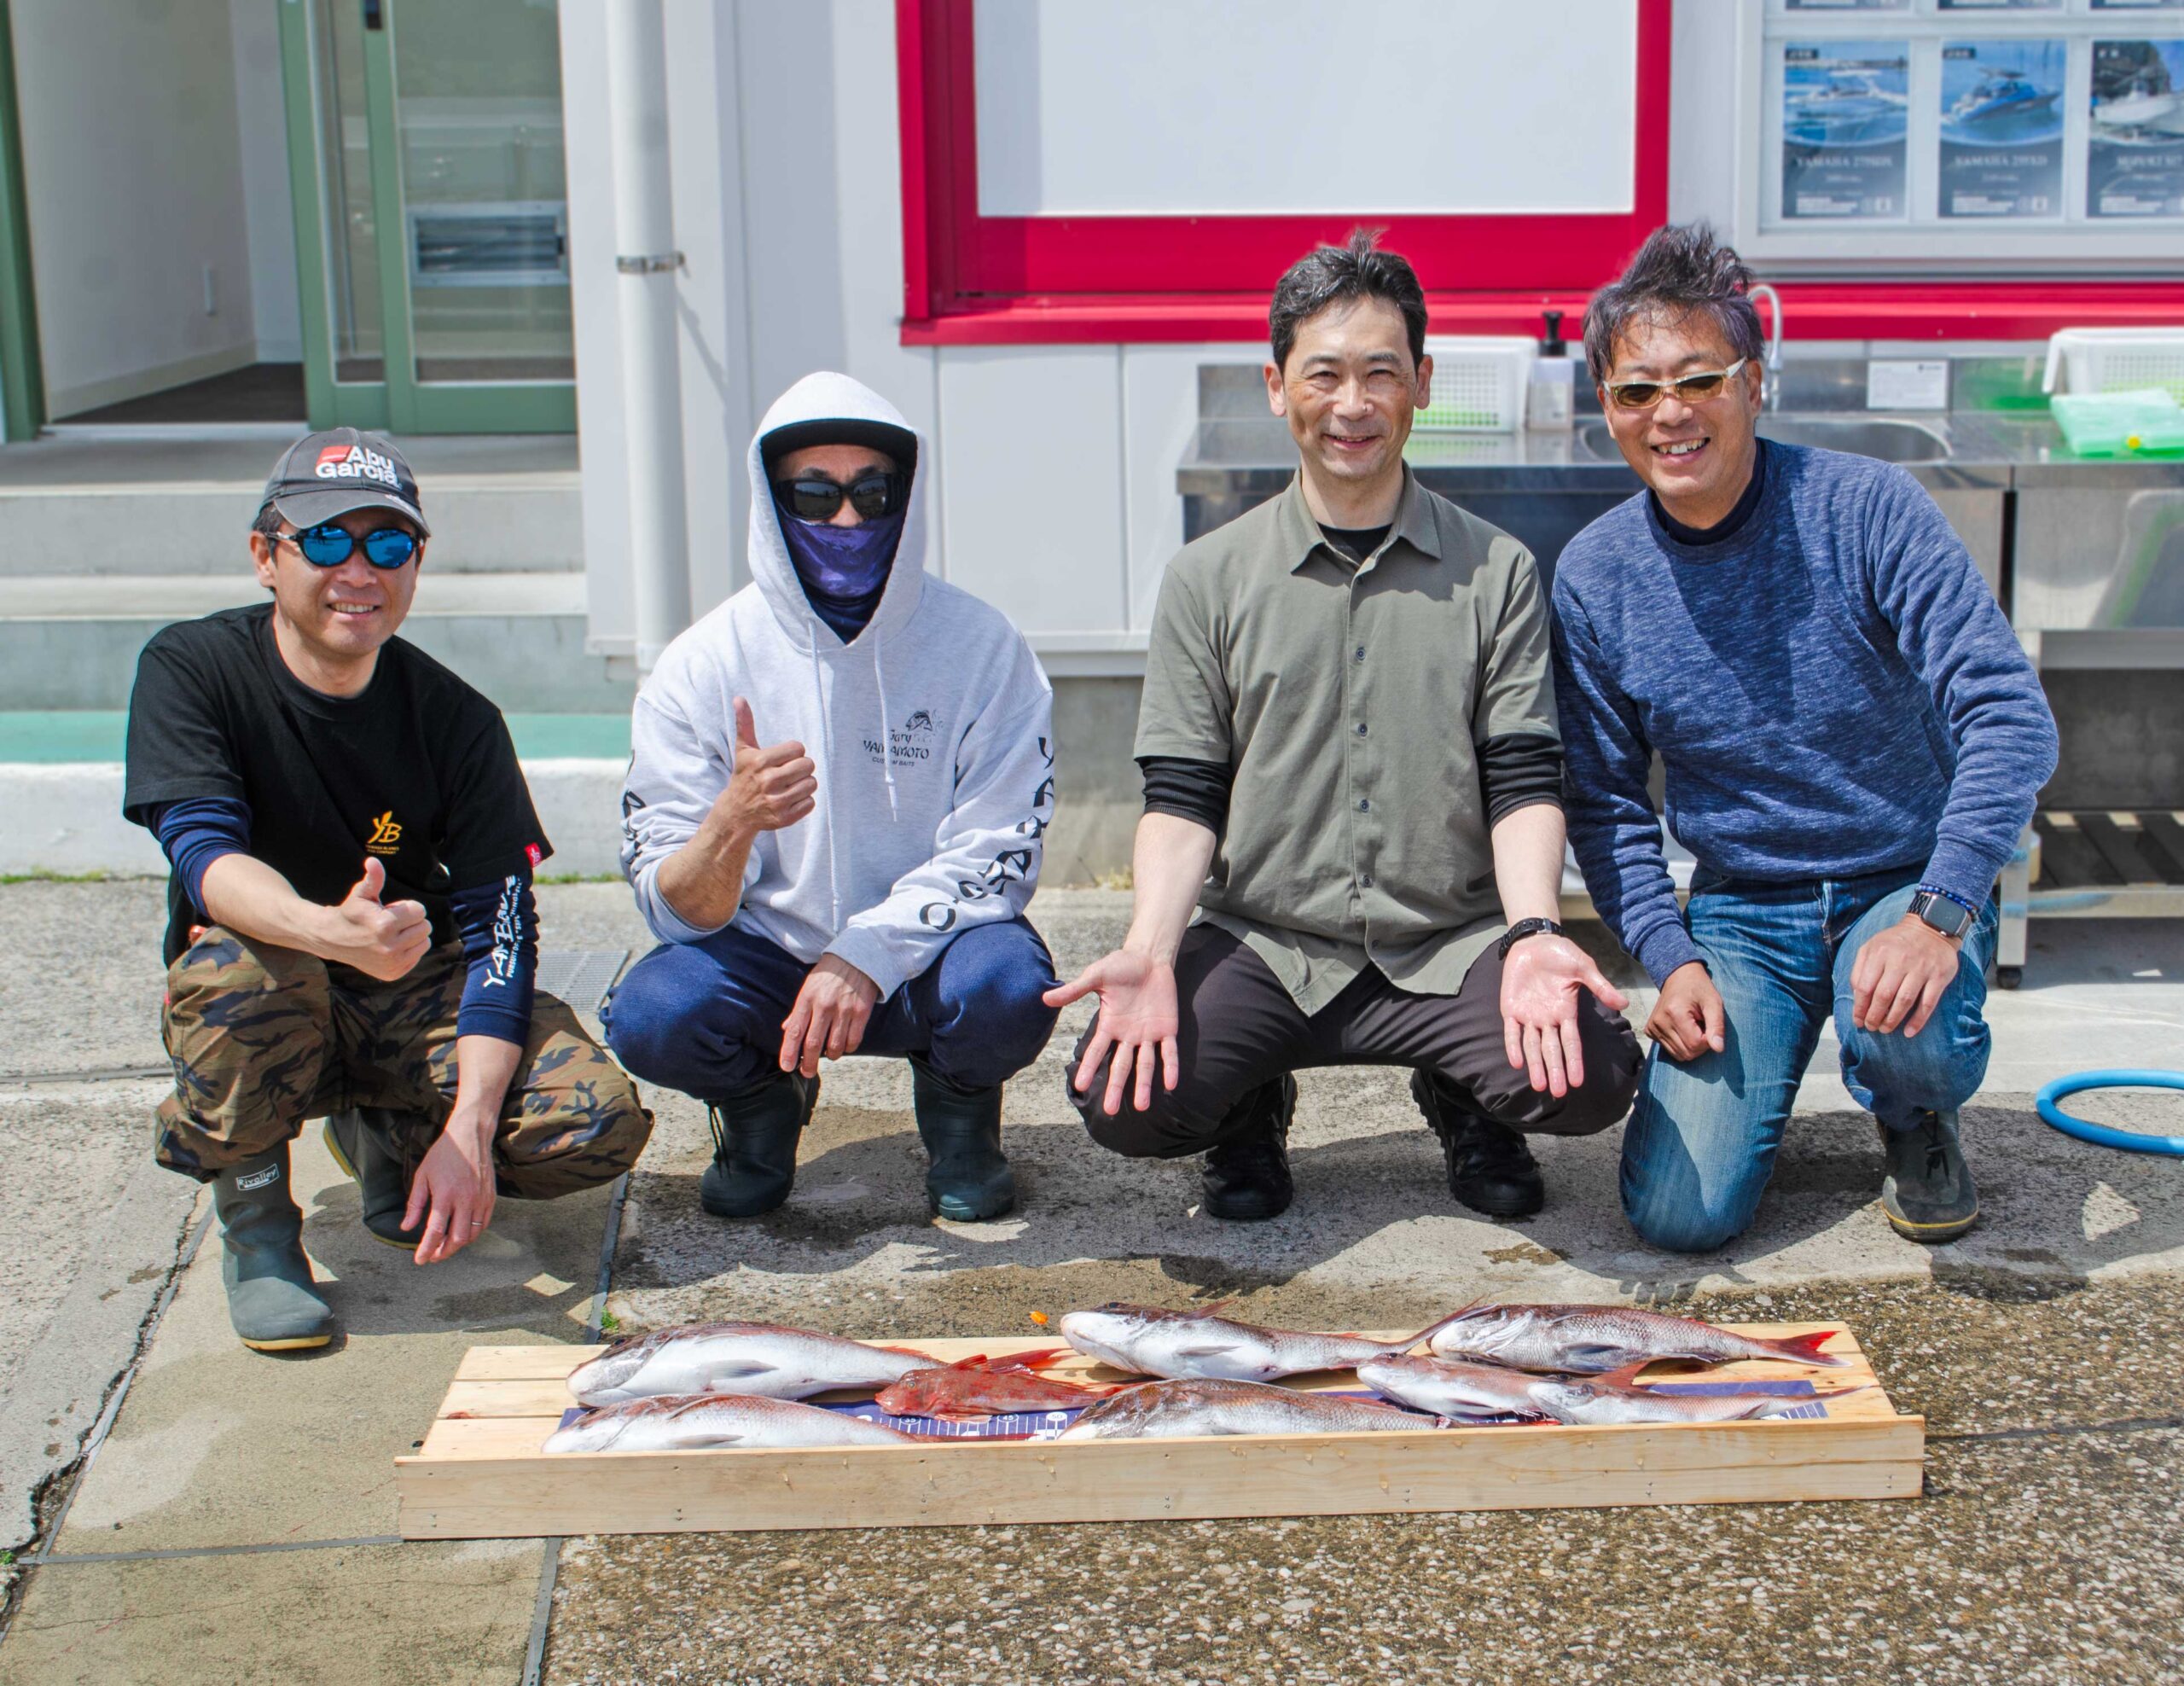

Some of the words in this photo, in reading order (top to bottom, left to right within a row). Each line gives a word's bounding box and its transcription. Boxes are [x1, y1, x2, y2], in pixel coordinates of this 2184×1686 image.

[346, 445, 395, 470] Abu
[315, 462, 398, 485] Garcia
[506, 951, 518, 978] PURSUIT
